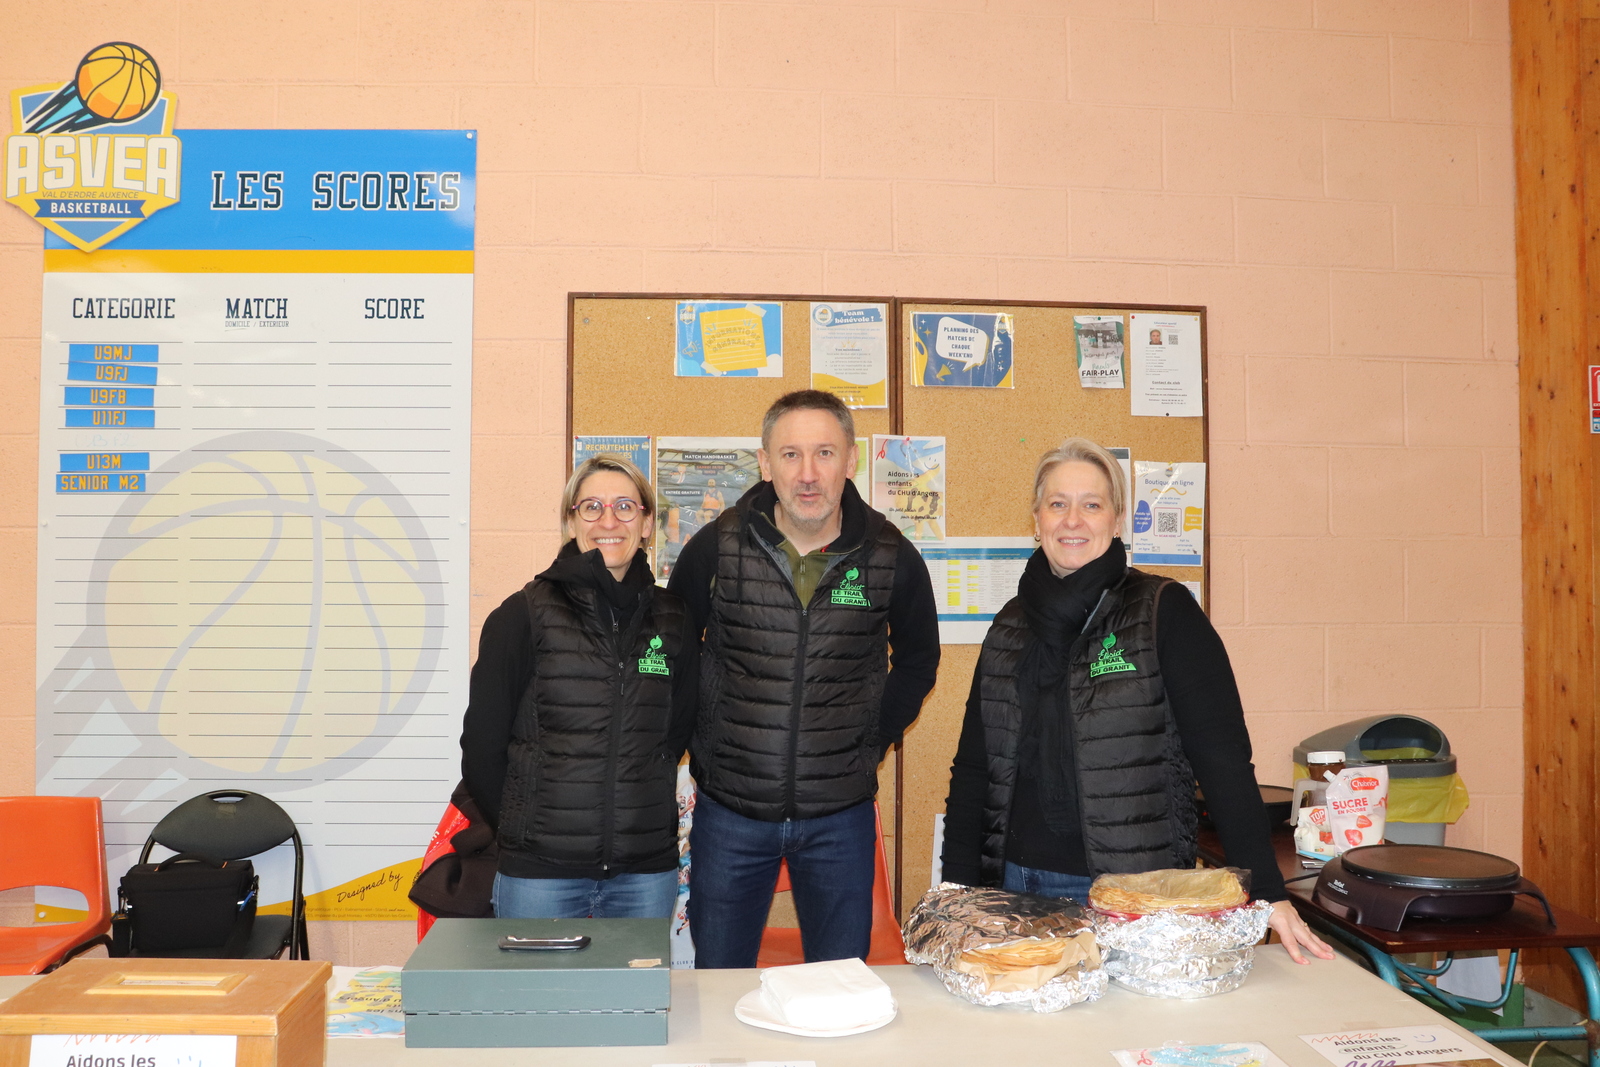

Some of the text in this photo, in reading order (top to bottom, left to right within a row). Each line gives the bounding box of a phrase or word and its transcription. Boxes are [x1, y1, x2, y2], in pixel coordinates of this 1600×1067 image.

[6, 135, 178, 199] ASVEA
[42, 191, 139, 199] VAL D'ERDRE AUXENCE
[210, 171, 461, 211] LES SCORES
[51, 202, 132, 214] BASKETBALL
[72, 298, 175, 319] CATEGORIE
[225, 298, 288, 319] MATCH
[364, 298, 425, 319] SCORE
[835, 316, 870, 324] bénévole
[944, 326, 969, 334] PLANNING
[94, 345, 132, 361] U9MJ
[95, 365, 129, 382] U9FJ
[1081, 369, 1120, 377] FAIR-PLAY
[90, 388, 126, 404] U9FB
[92, 410, 126, 425] U11FJ
[585, 443, 640, 451] RECRUTEMENT
[86, 454, 122, 470] U13M
[60, 475, 139, 490] SENIOR M2
[1179, 479, 1195, 487] ligne
[911, 490, 939, 498] d'Angers
[1102, 657, 1121, 665] TRAIL
[1102, 664, 1130, 673] GRANIT
[1332, 797, 1369, 810] SUCRE
[1309, 809, 1326, 822] TOP
[337, 872, 387, 903] Designed
[388, 870, 404, 892] by
[1334, 1035, 1402, 1047] Aidons les
[1343, 1043, 1397, 1054] enfants
[1353, 1046, 1463, 1061] du CHU d'Angers
[65, 1053, 157, 1067] Aidons les
